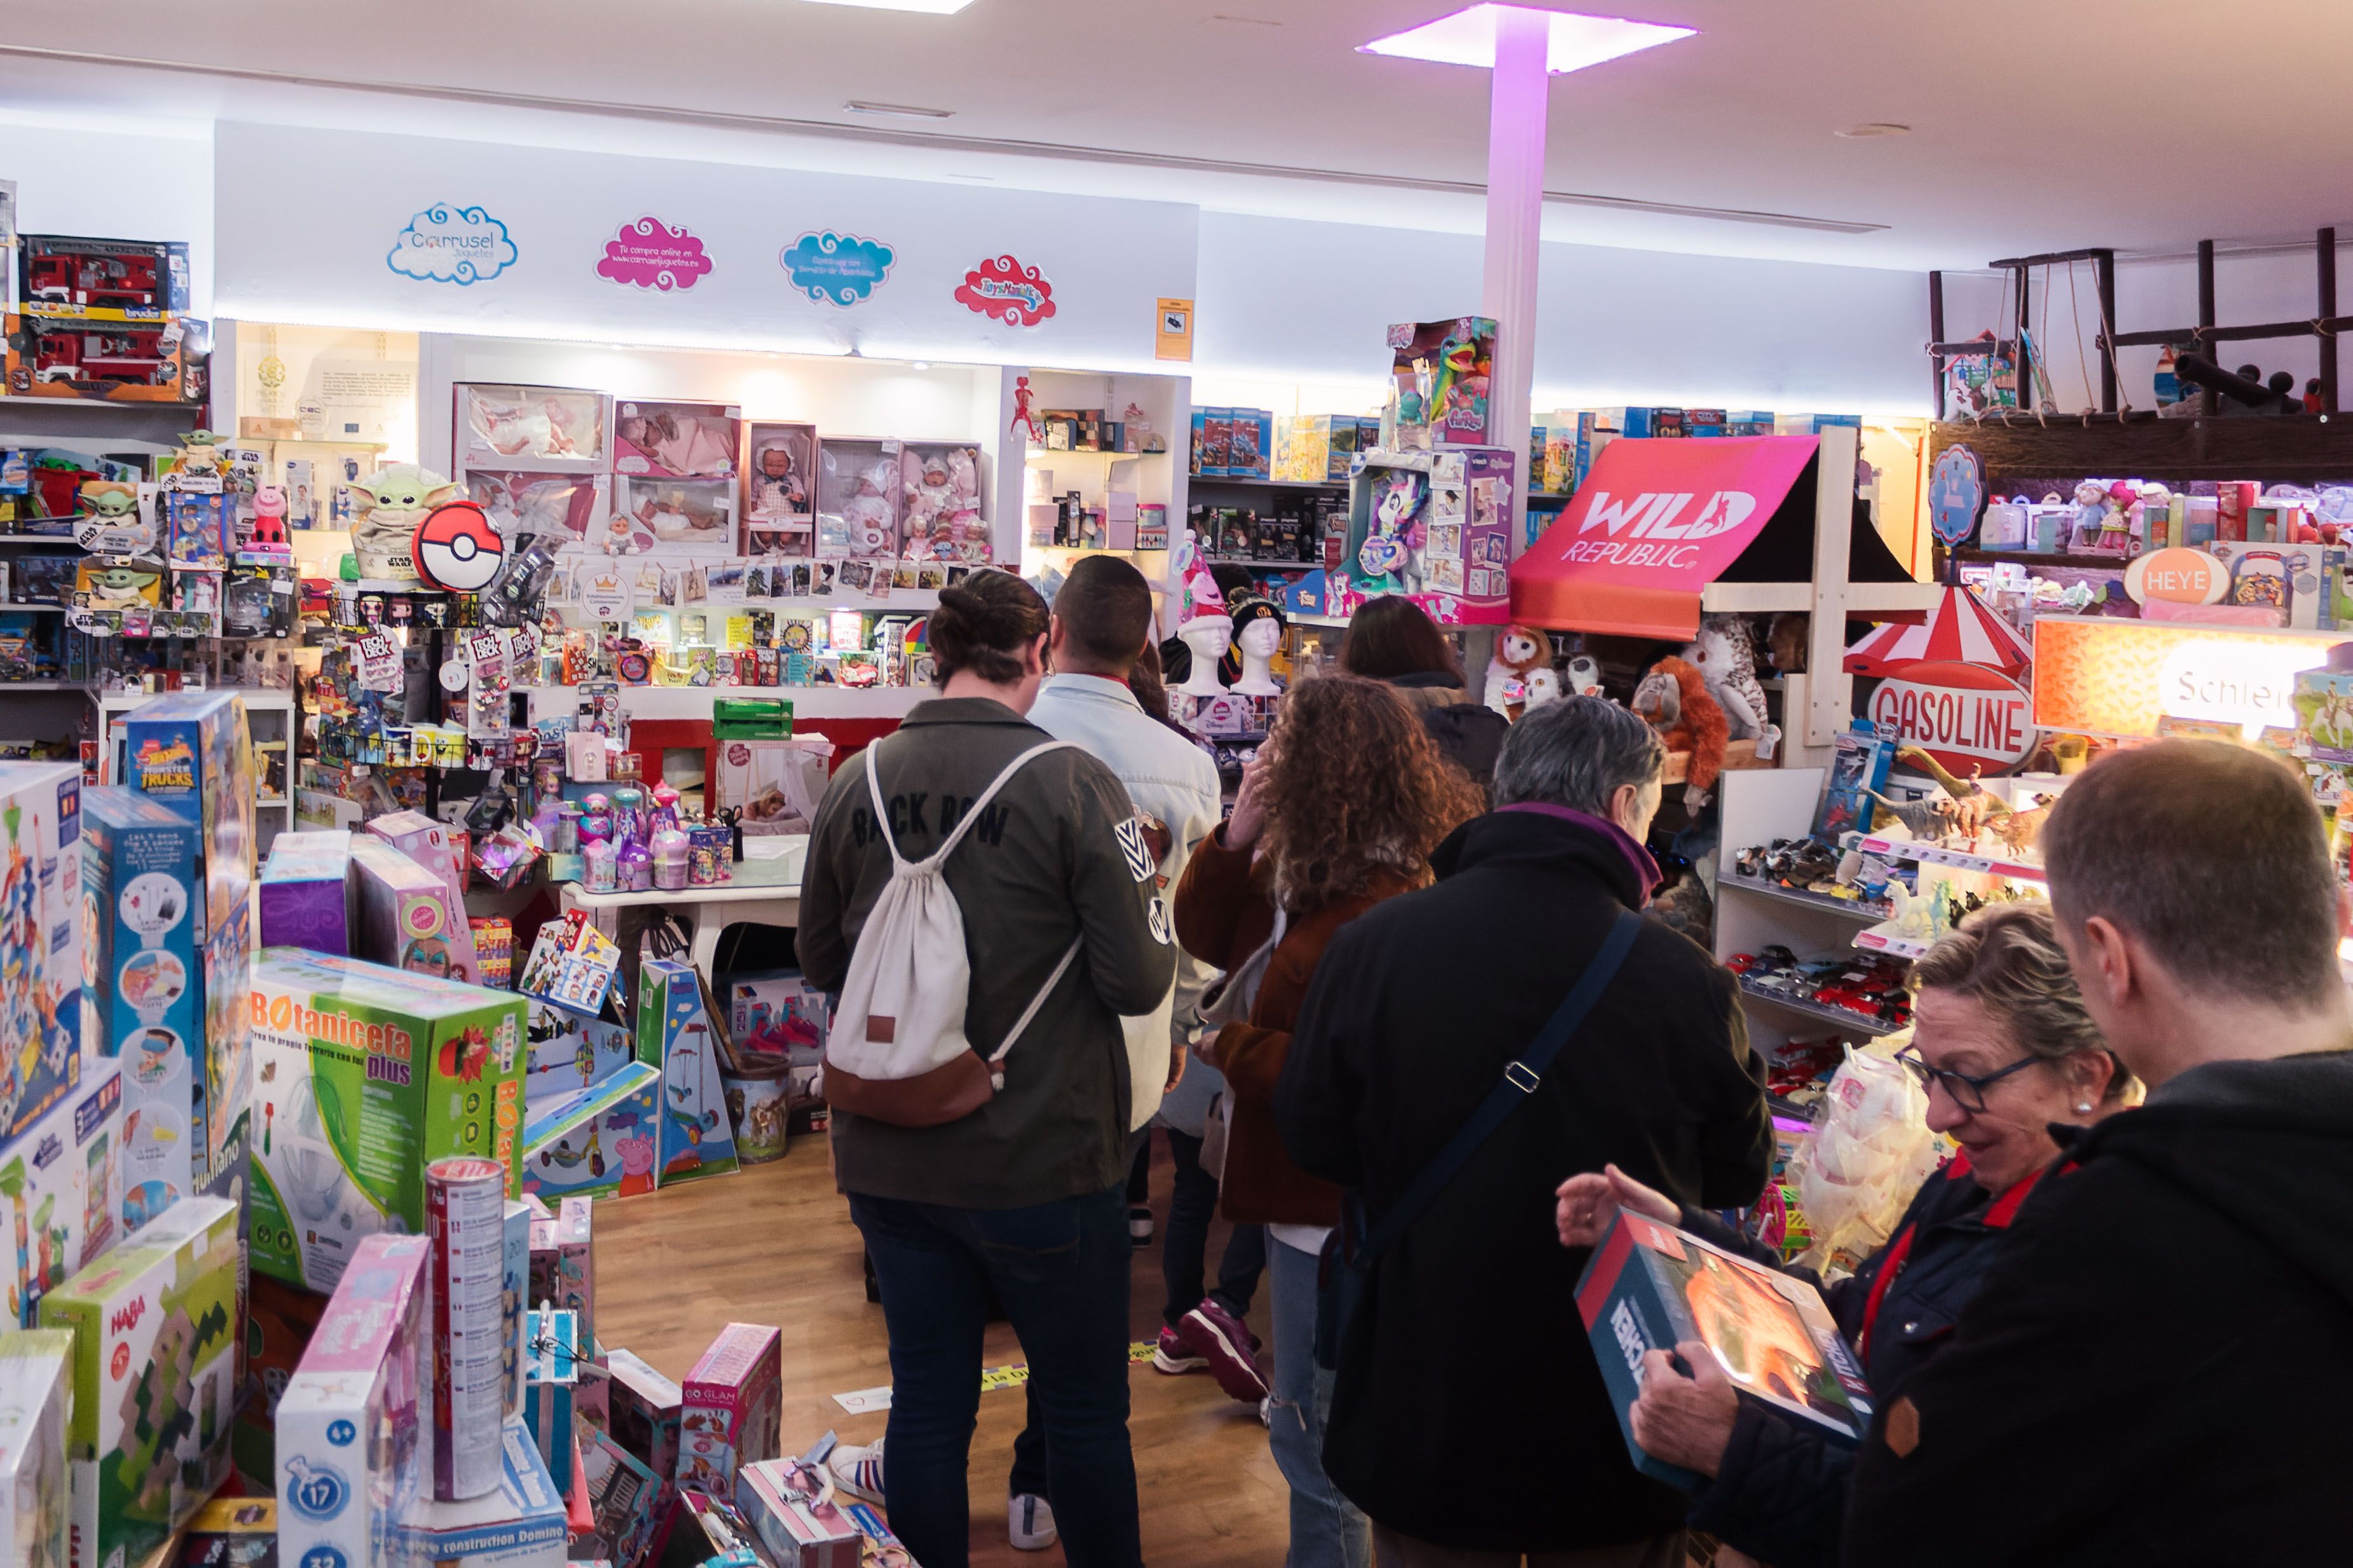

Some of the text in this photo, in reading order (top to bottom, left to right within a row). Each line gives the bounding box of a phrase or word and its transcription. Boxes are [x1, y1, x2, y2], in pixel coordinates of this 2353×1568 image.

[411, 232, 493, 248] Carrusel
[619, 245, 628, 254] Tu
[631, 247, 659, 256] compra
[661, 247, 682, 257] online
[612, 256, 699, 268] www.carruseljuguetes.es
[1578, 491, 1757, 539] WILD
[1561, 541, 1700, 568] REPUBLIC
[2147, 571, 2206, 590] HEYE
[360, 634, 385, 650] TECH
[473, 634, 495, 649] TECH
[512, 632, 530, 647] TECH
[365, 646, 391, 659] DECK
[477, 646, 500, 660] DECK
[516, 644, 533, 657] DECK
[2178, 671, 2293, 709] Schlei
[1876, 686, 2024, 753] GASOLINE
[141, 772, 195, 788] TRUCKS
[853, 793, 1009, 848] BACK ROW
[278, 1037, 303, 1051] propio
[305, 1043, 335, 1060] Terrario
[337, 1051, 351, 1063] con
[366, 1055, 411, 1086] plus
[497, 1081, 518, 1199] Botanic
[112, 1295, 145, 1337] HABA
[686, 1389, 701, 1398] GO
[704, 1390, 735, 1401] GLAM
[310, 1485, 330, 1506] 17
[444, 1533, 515, 1555] construction
[518, 1526, 564, 1543] Domino
